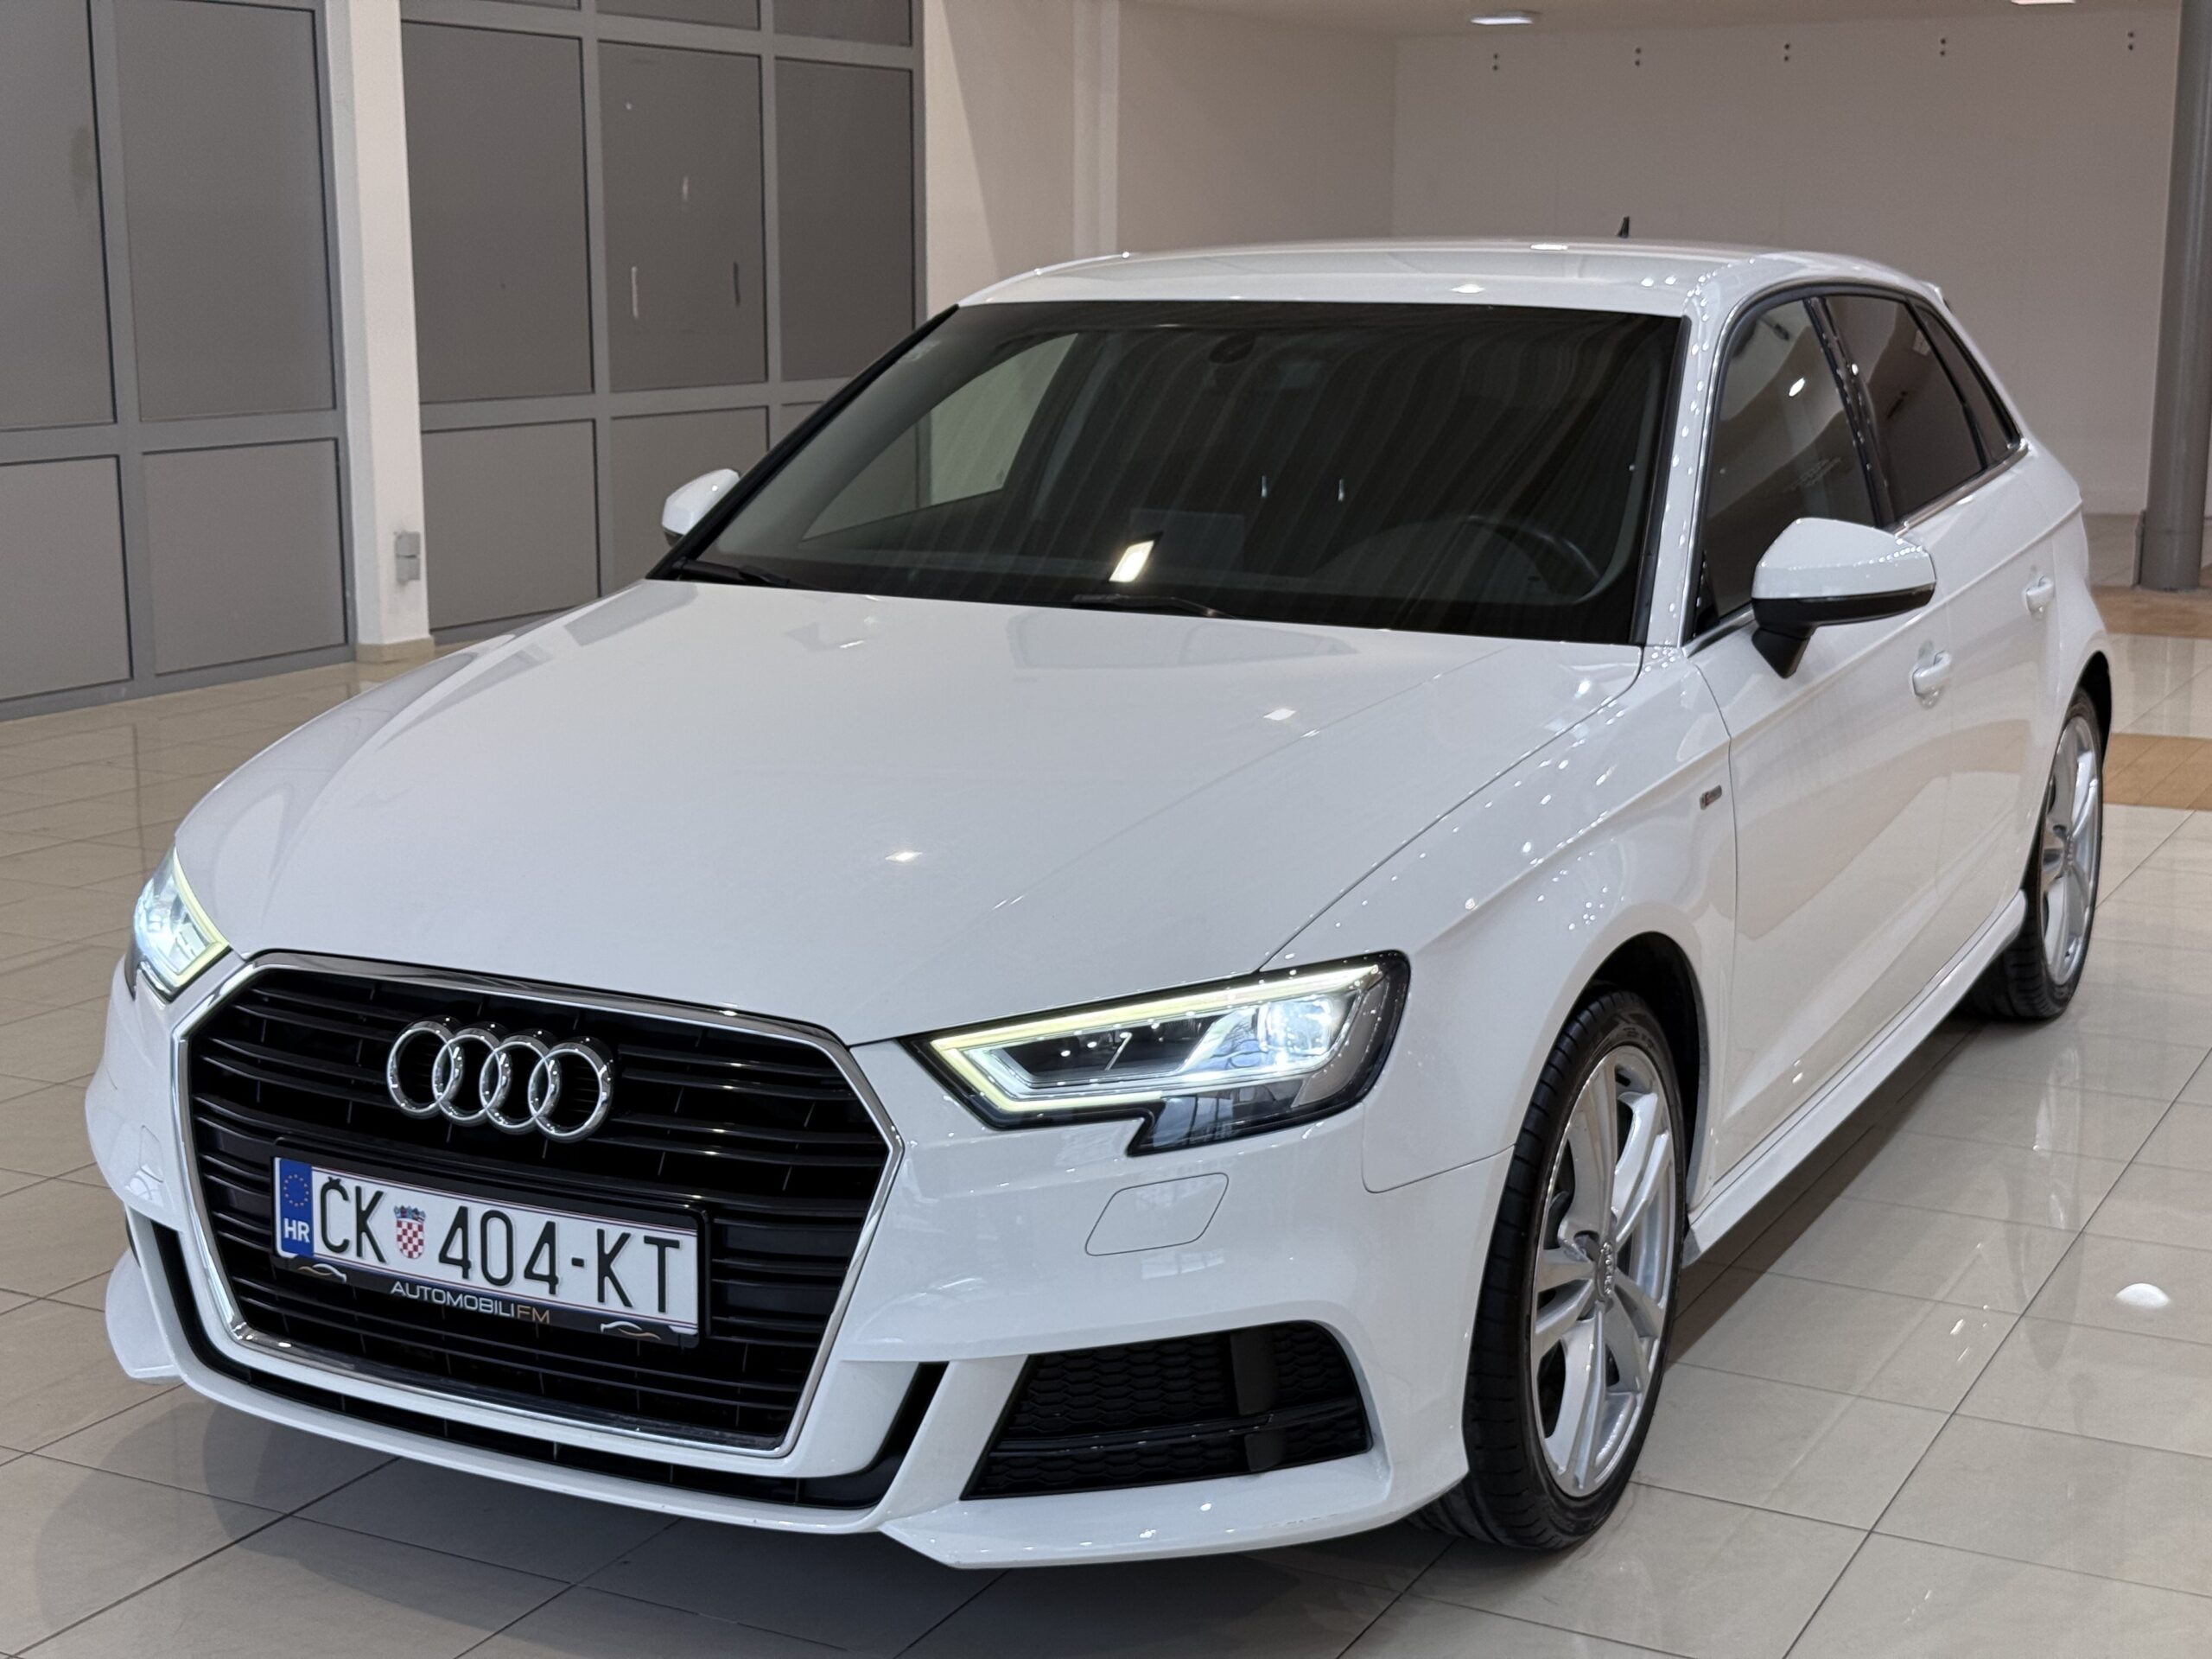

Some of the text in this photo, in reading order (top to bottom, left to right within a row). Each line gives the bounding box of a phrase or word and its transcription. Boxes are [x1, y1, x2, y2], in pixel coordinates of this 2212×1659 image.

[284, 1217, 310, 1243] HR
[320, 1177, 680, 1313] ČK 404-KT
